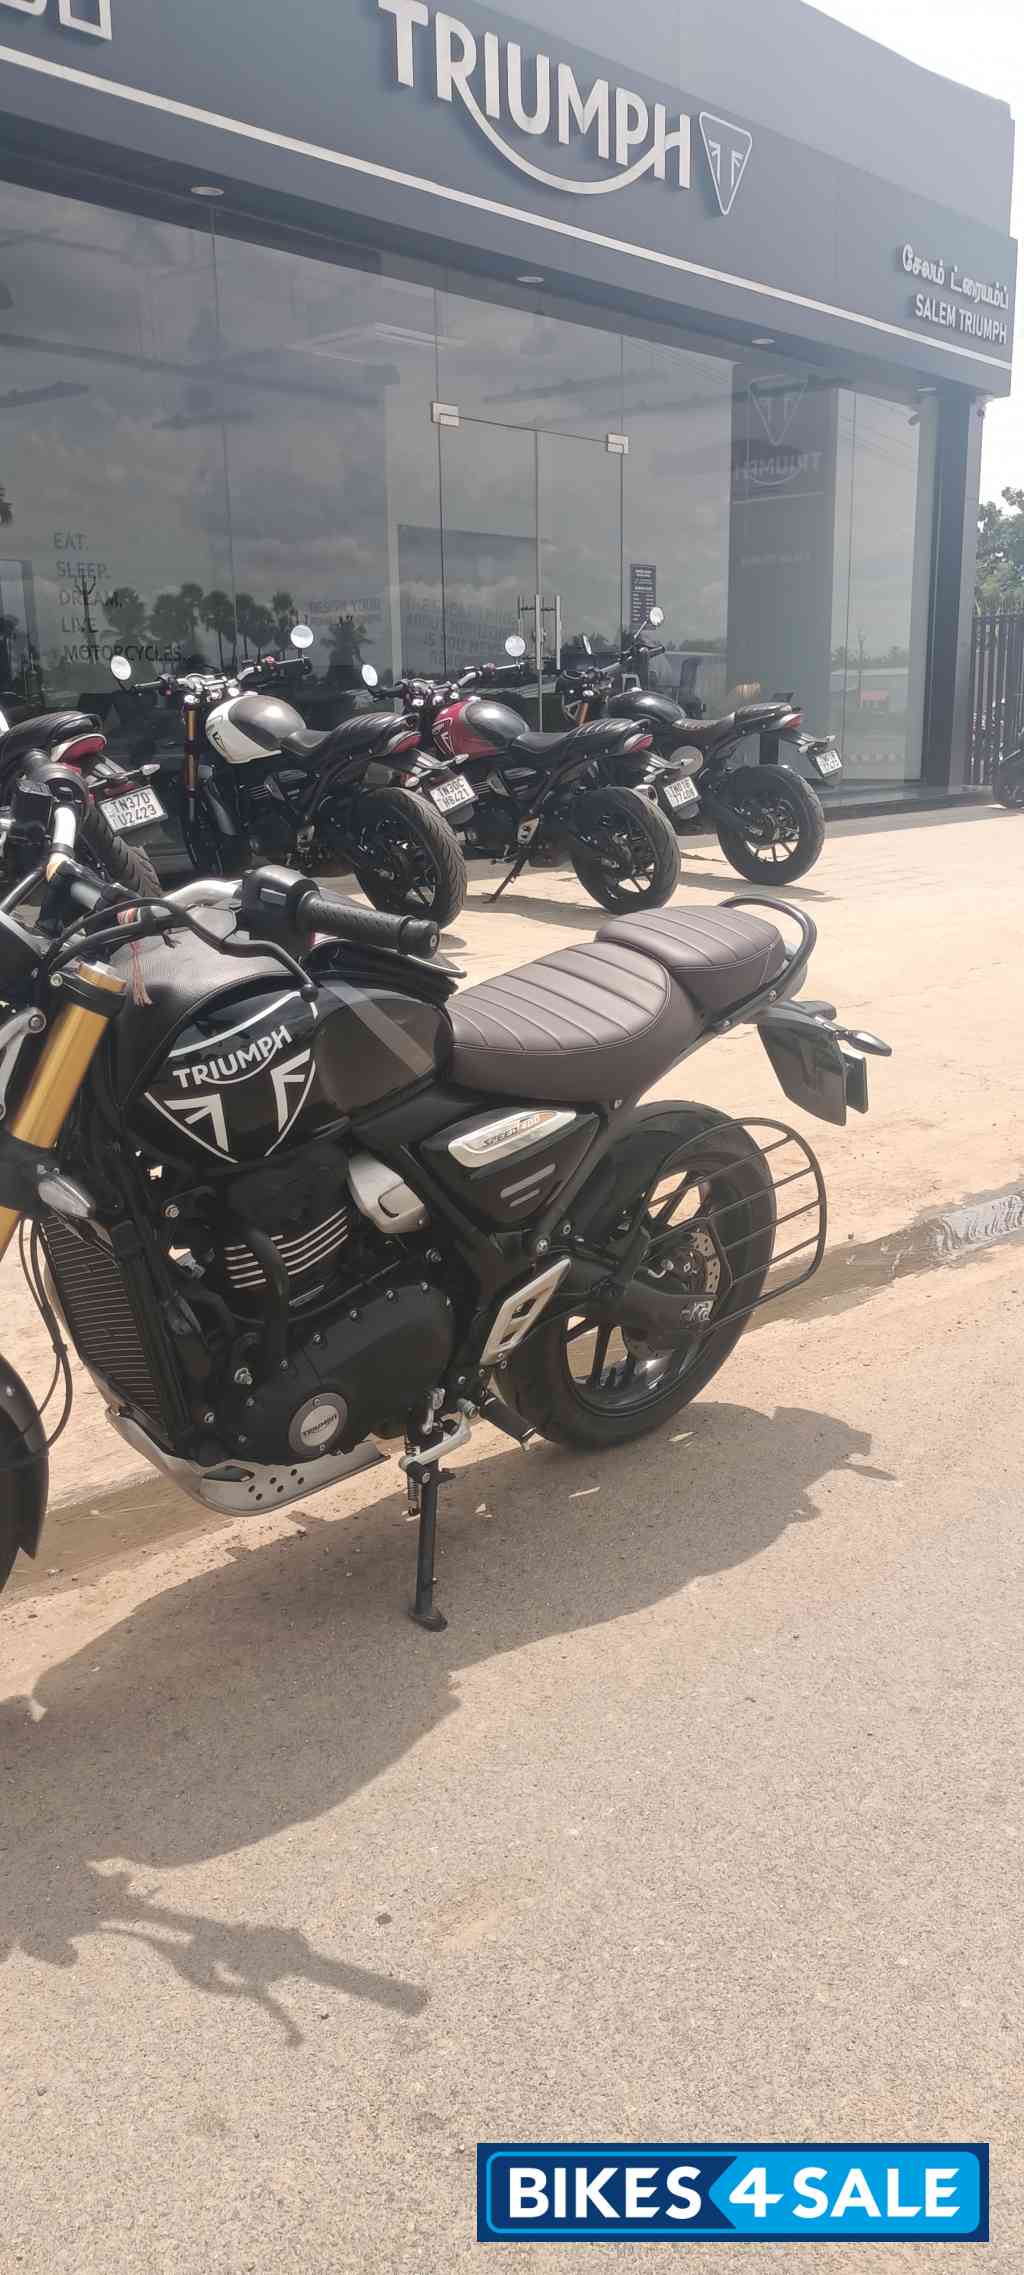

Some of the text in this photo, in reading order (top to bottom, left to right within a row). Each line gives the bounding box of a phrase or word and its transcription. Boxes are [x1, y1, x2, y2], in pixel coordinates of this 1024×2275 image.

[378, 0, 690, 194] TRIUMPH
[915, 293, 1007, 344] SALEM TRIUMPH
[172, 1025, 293, 1089] TRIUMPH
